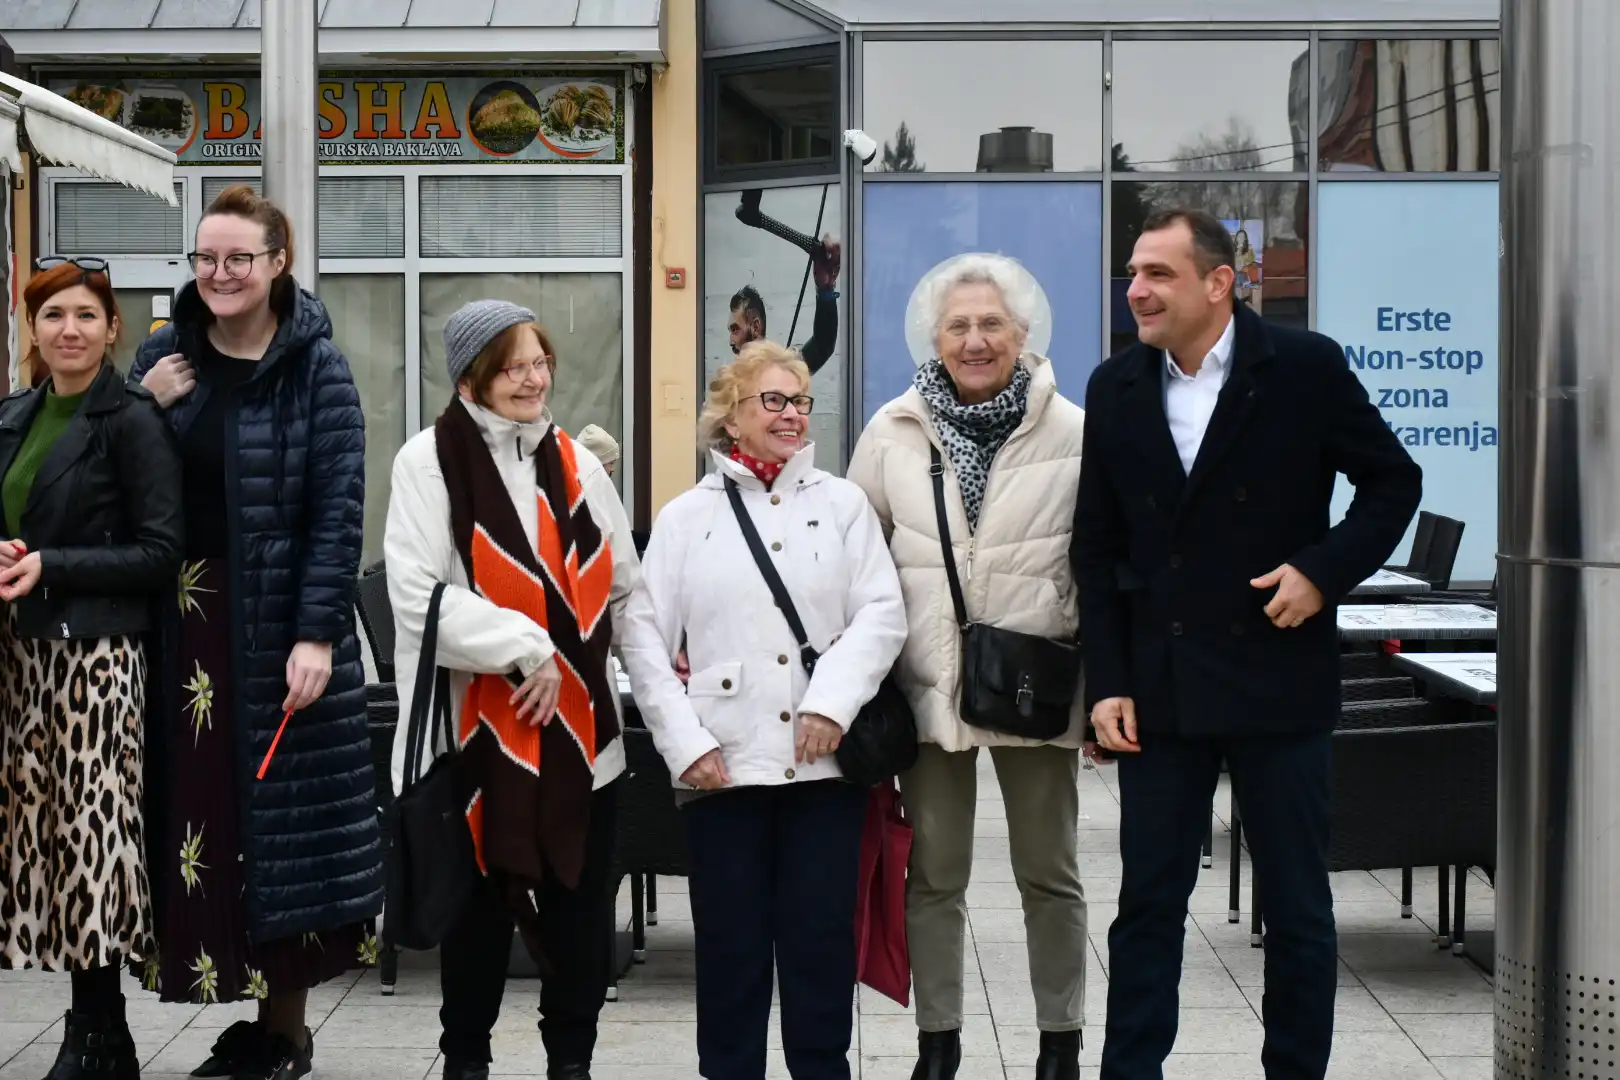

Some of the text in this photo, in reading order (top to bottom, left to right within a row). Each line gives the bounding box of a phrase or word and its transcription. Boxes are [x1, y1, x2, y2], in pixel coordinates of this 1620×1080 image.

[202, 82, 461, 139] BSHA
[202, 143, 262, 156] ORIGIN
[383, 143, 462, 156] BAKLAVA
[1377, 307, 1451, 331] Erste
[1345, 346, 1483, 374] Non-stop
[1377, 388, 1448, 408] zona
